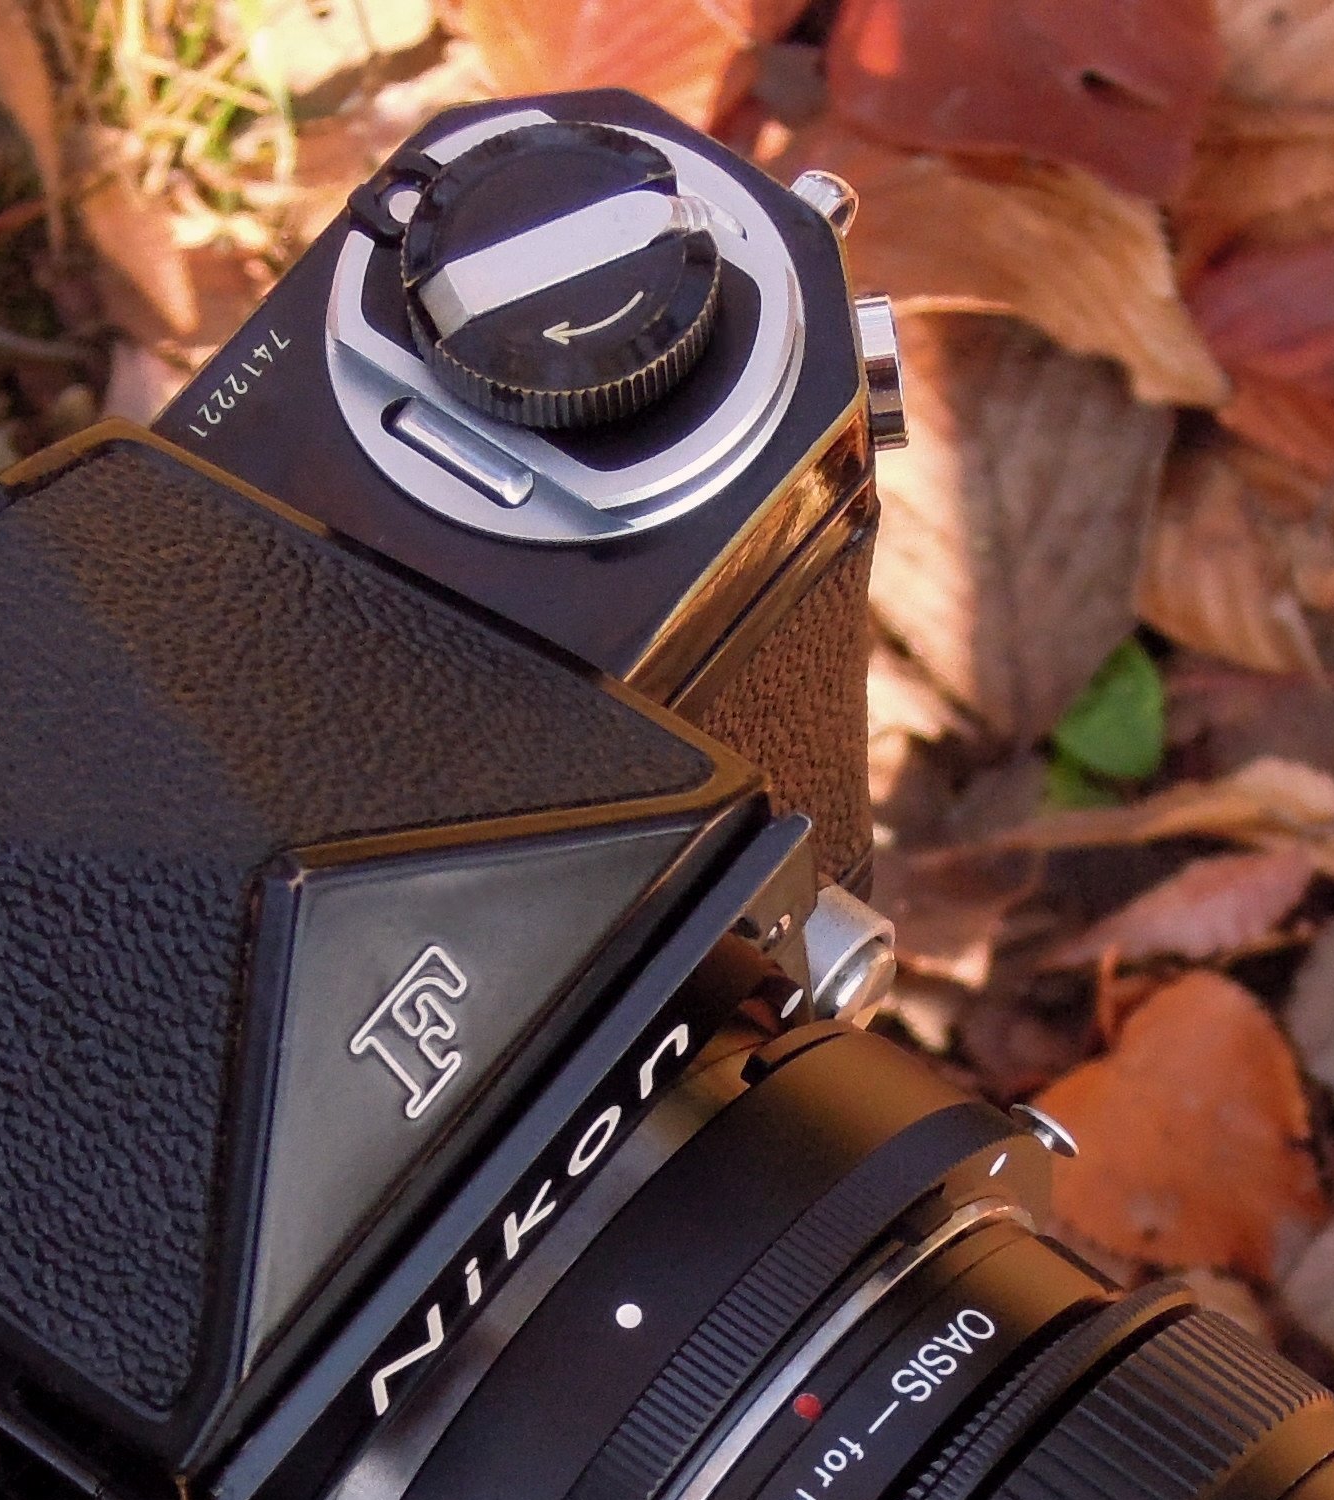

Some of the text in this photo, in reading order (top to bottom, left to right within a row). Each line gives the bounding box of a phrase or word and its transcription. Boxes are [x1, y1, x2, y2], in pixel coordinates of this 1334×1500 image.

[188, 329, 291, 438] 7412221
[350, 945, 468, 1120] F
[370, 1023, 689, 1417] Nikon
[890, 1308, 996, 1403] OASIS
[813, 1436, 865, 1488] for
